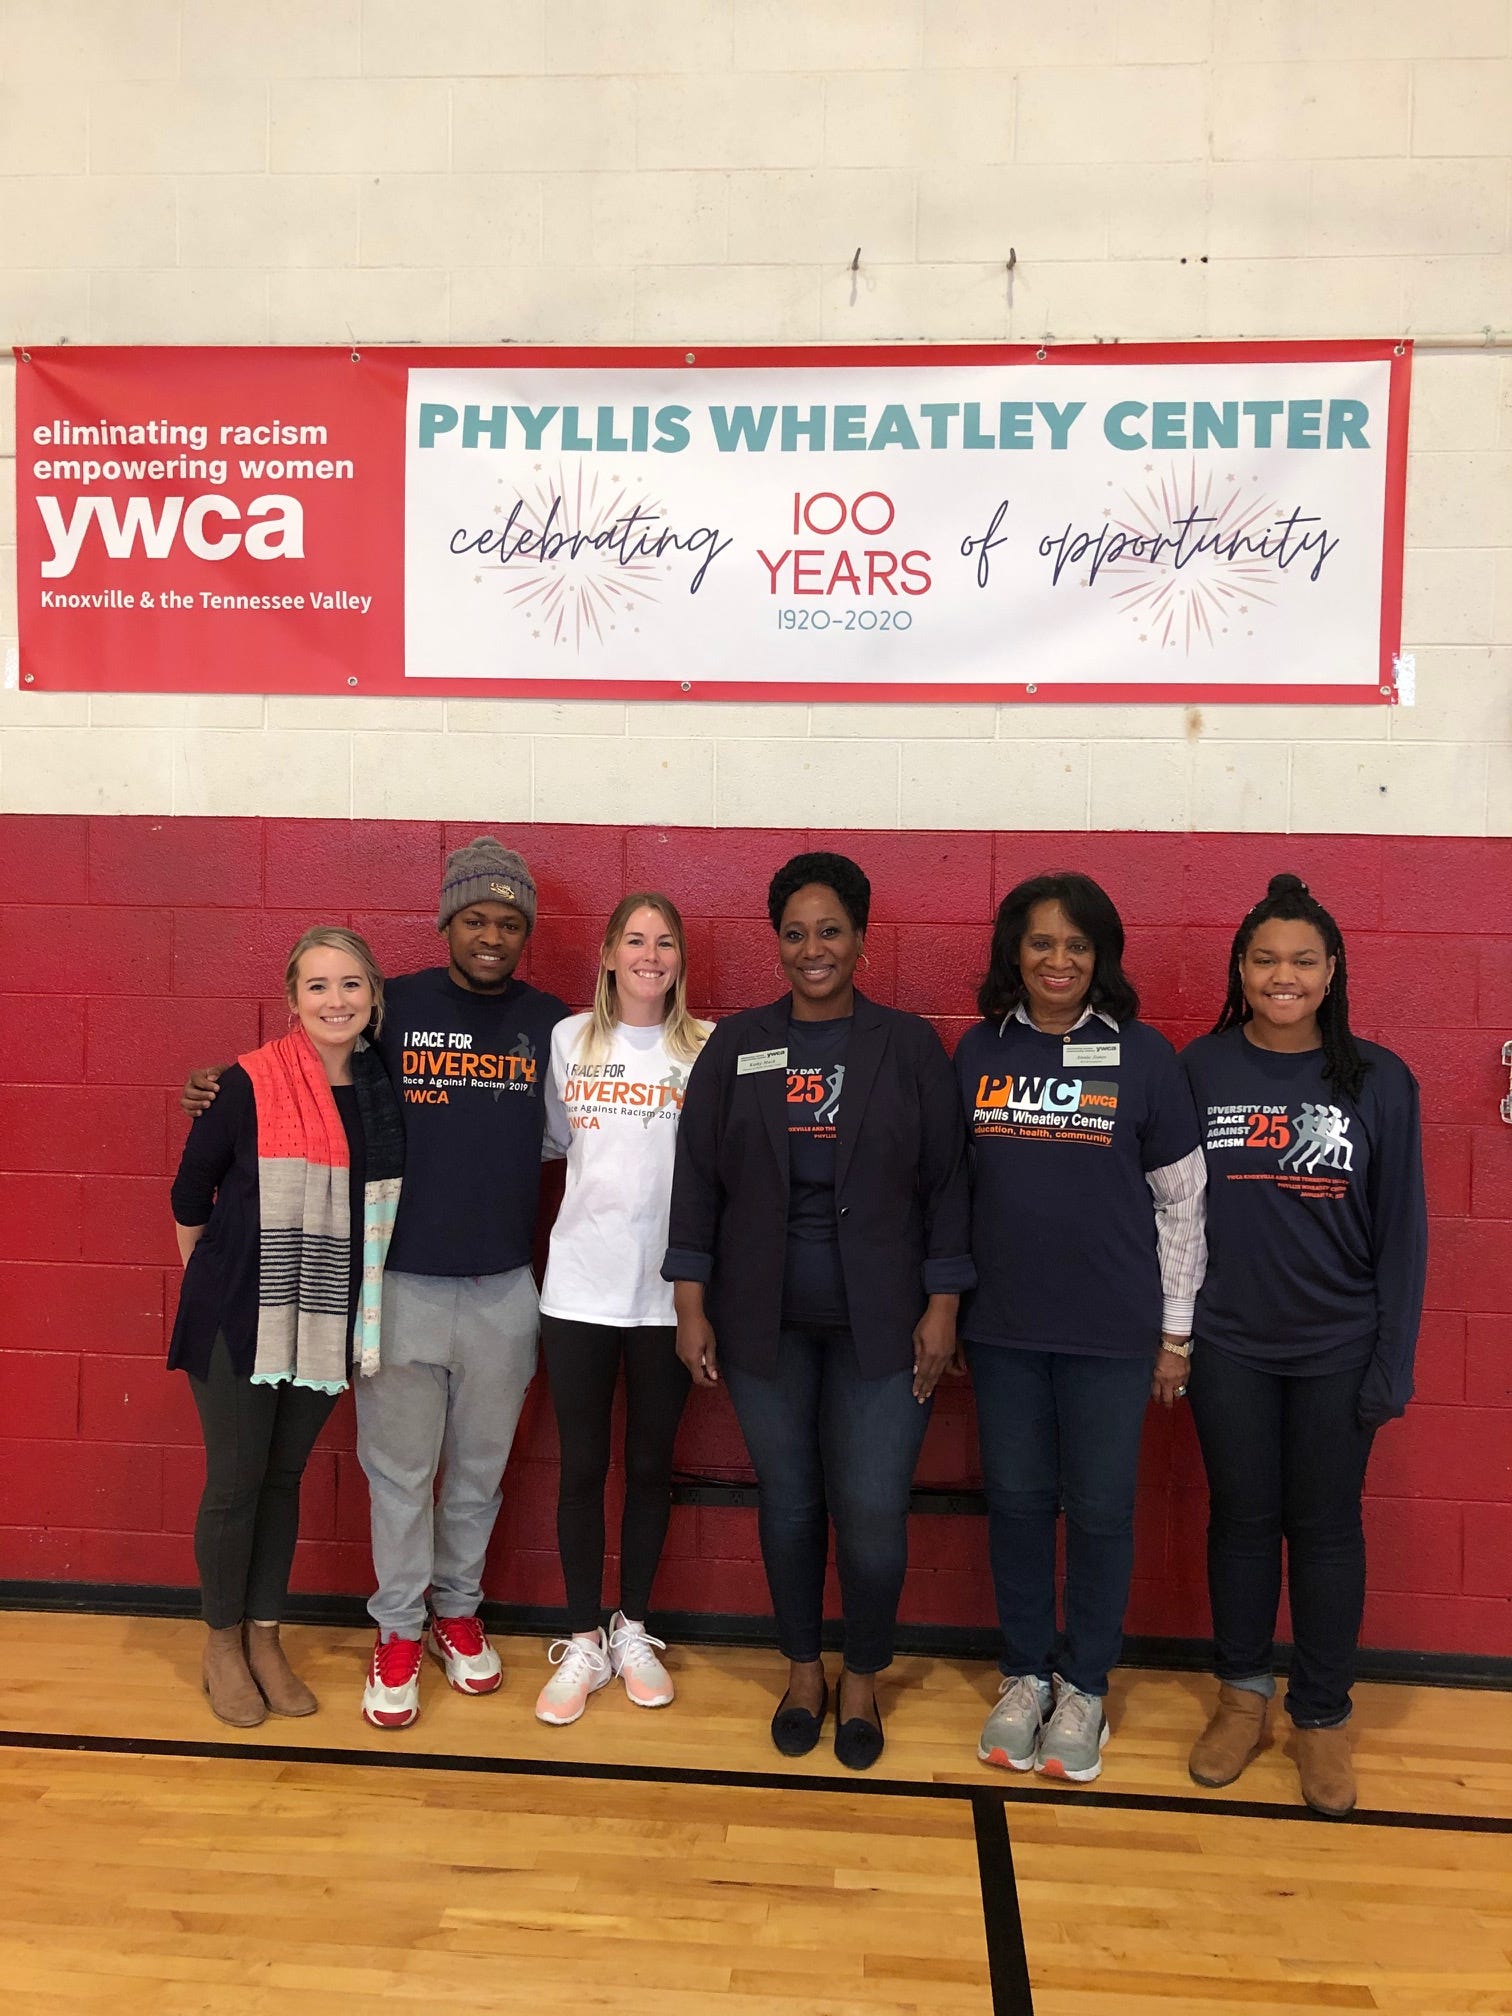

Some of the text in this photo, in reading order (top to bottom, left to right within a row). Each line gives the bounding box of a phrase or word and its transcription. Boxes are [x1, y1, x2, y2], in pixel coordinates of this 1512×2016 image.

[33, 420, 328, 450] eliminating racism
[419, 399, 1372, 453] PHYLLIS WHEATLEY CENTER
[33, 454, 354, 485] empowering women
[793, 491, 895, 536] 100
[35, 494, 305, 578] ywca
[449, 495, 733, 595] celebrating
[960, 500, 1340, 588] of opportunity
[757, 550, 932, 596] YEARS
[41, 591, 372, 614] Knoxville & the Tennessee Valley
[777, 609, 912, 631] 1920-2020
[404, 1032, 472, 1049] I RACE FOR
[603, 1064, 625, 1077] FOR
[403, 1076, 528, 1091] Race Against Racism 2019
[786, 1075, 825, 1103] 25
[978, 1075, 1118, 1109] PWC ywca
[403, 1090, 449, 1104] YWCA
[581, 1104, 617, 1114] Against
[621, 1107, 655, 1118] Racism
[973, 1109, 1115, 1130] Phyllis Wheatley Center
[1207, 1105, 1287, 1115] DIVERSITY DAY
[1217, 1115, 1245, 1124] RACE
[1055, 1131, 1112, 1144] community
[1207, 1127, 1250, 1137] AGAINST
[1246, 1113, 1290, 1149] 25
[1207, 1138, 1244, 1149] RACISM
